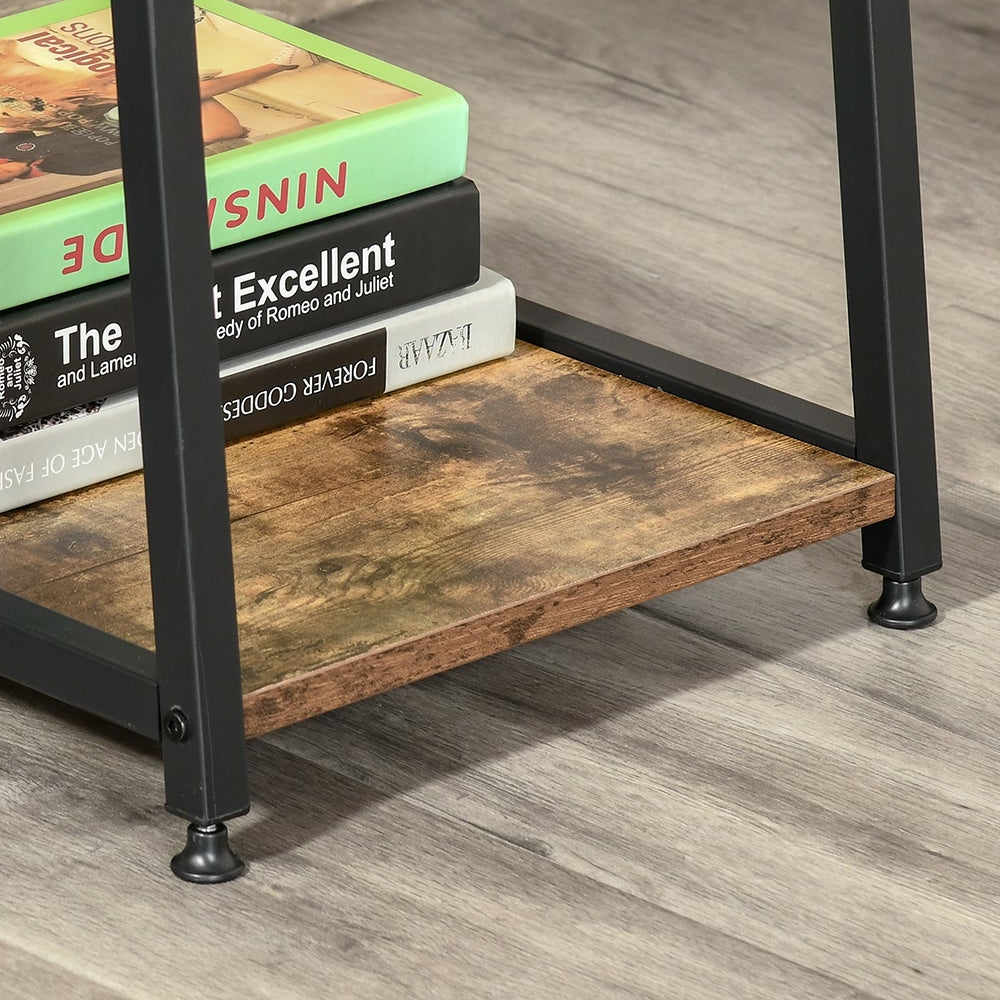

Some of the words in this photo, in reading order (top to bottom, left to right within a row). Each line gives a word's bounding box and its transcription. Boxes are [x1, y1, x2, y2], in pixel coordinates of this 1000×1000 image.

[17, 31, 116, 78] logical
[60, 22, 115, 56] tions
[54, 322, 122, 365] The
[234, 231, 395, 313] Excellent
[56, 363, 86, 388] and
[216, 318, 244, 340] edy
[248, 312, 262, 330] of
[266, 298, 319, 325] Romeo
[324, 286, 350, 308] and
[355, 272, 394, 298] Juliet
[398, 322, 473, 370] BAZAAR
[6, 365, 14, 388] and
[13, 356, 22, 391] Juliet
[303, 356, 377, 396] FOREVER
[220, 382, 297, 422] GODDES
[41, 453, 65, 478] OF
[72, 439, 108, 469] AGE
